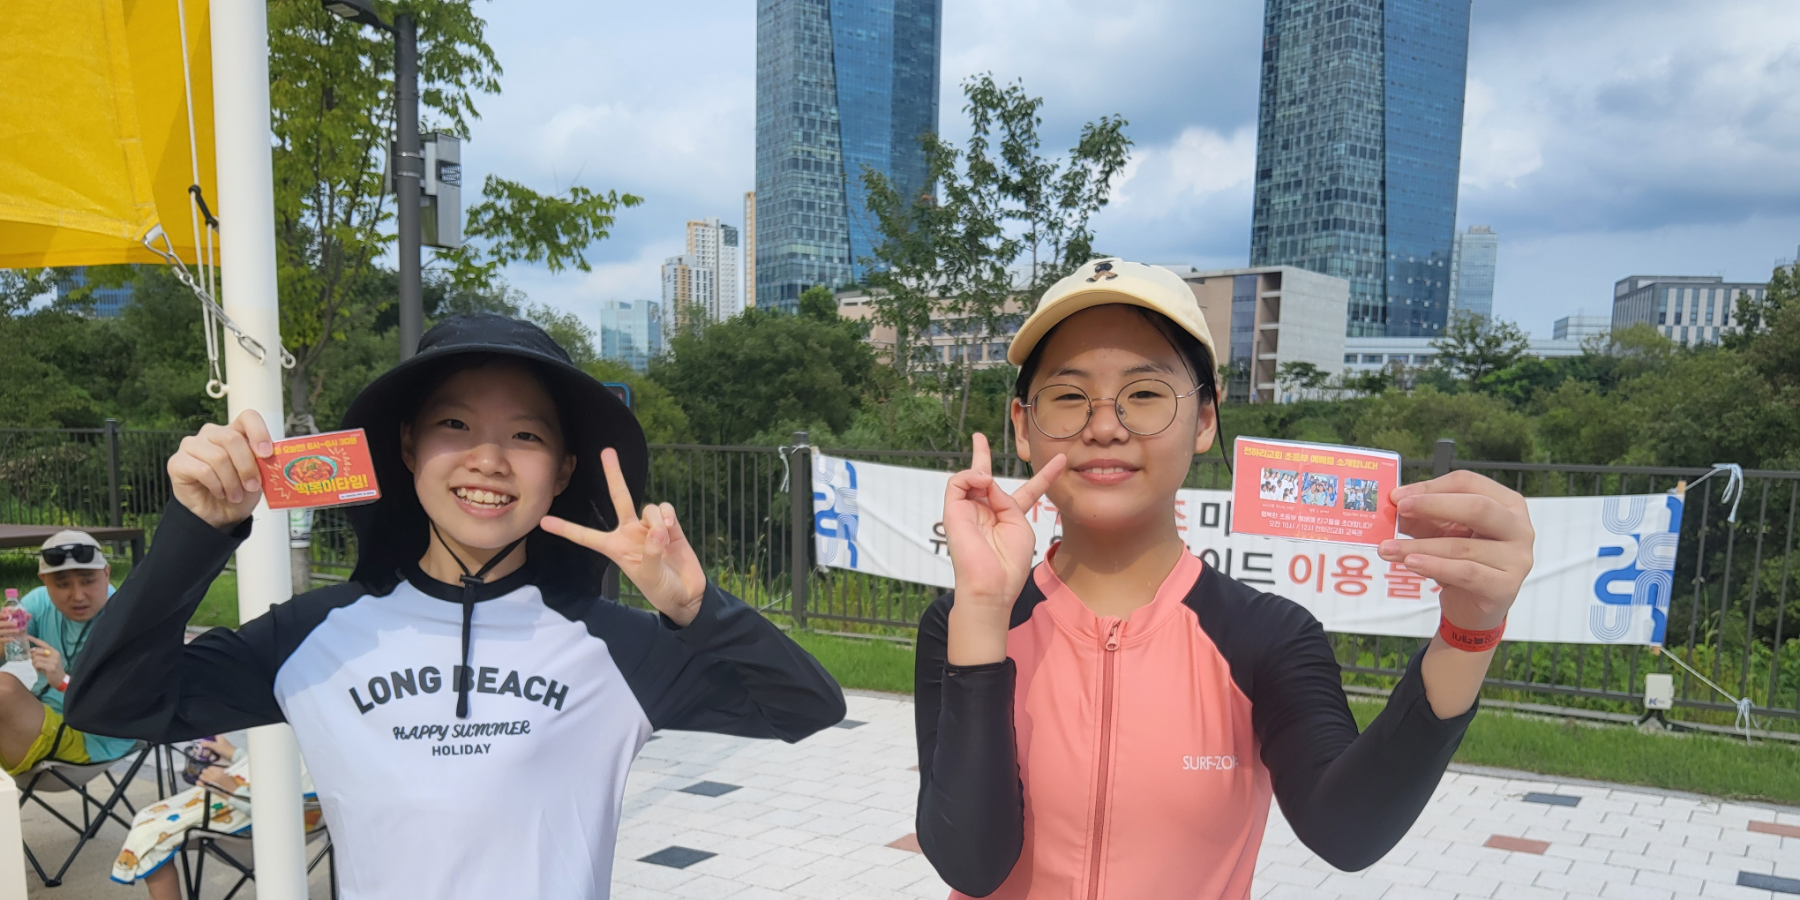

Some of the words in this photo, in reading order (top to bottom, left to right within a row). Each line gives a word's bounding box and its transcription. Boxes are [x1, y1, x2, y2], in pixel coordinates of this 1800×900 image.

[1284, 451, 1309, 463] 초등부
[1336, 458, 1378, 470] 소개합니다!
[295, 473, 369, 496] 떡볶이타임!
[1268, 519, 1280, 529] 오전
[1281, 521, 1295, 530] 10시
[1300, 523, 1314, 532] 12시
[1341, 518, 1373, 530] 초대합니다!
[1199, 548, 1276, 585] 이드
[1288, 553, 1373, 597] 이용
[1384, 561, 1443, 600] 불
[348, 666, 442, 715] LONG
[452, 664, 569, 712] BEACH
[392, 724, 449, 742] HAPPY
[451, 719, 531, 739] SUMMER
[431, 743, 491, 757] HOLIDAY
